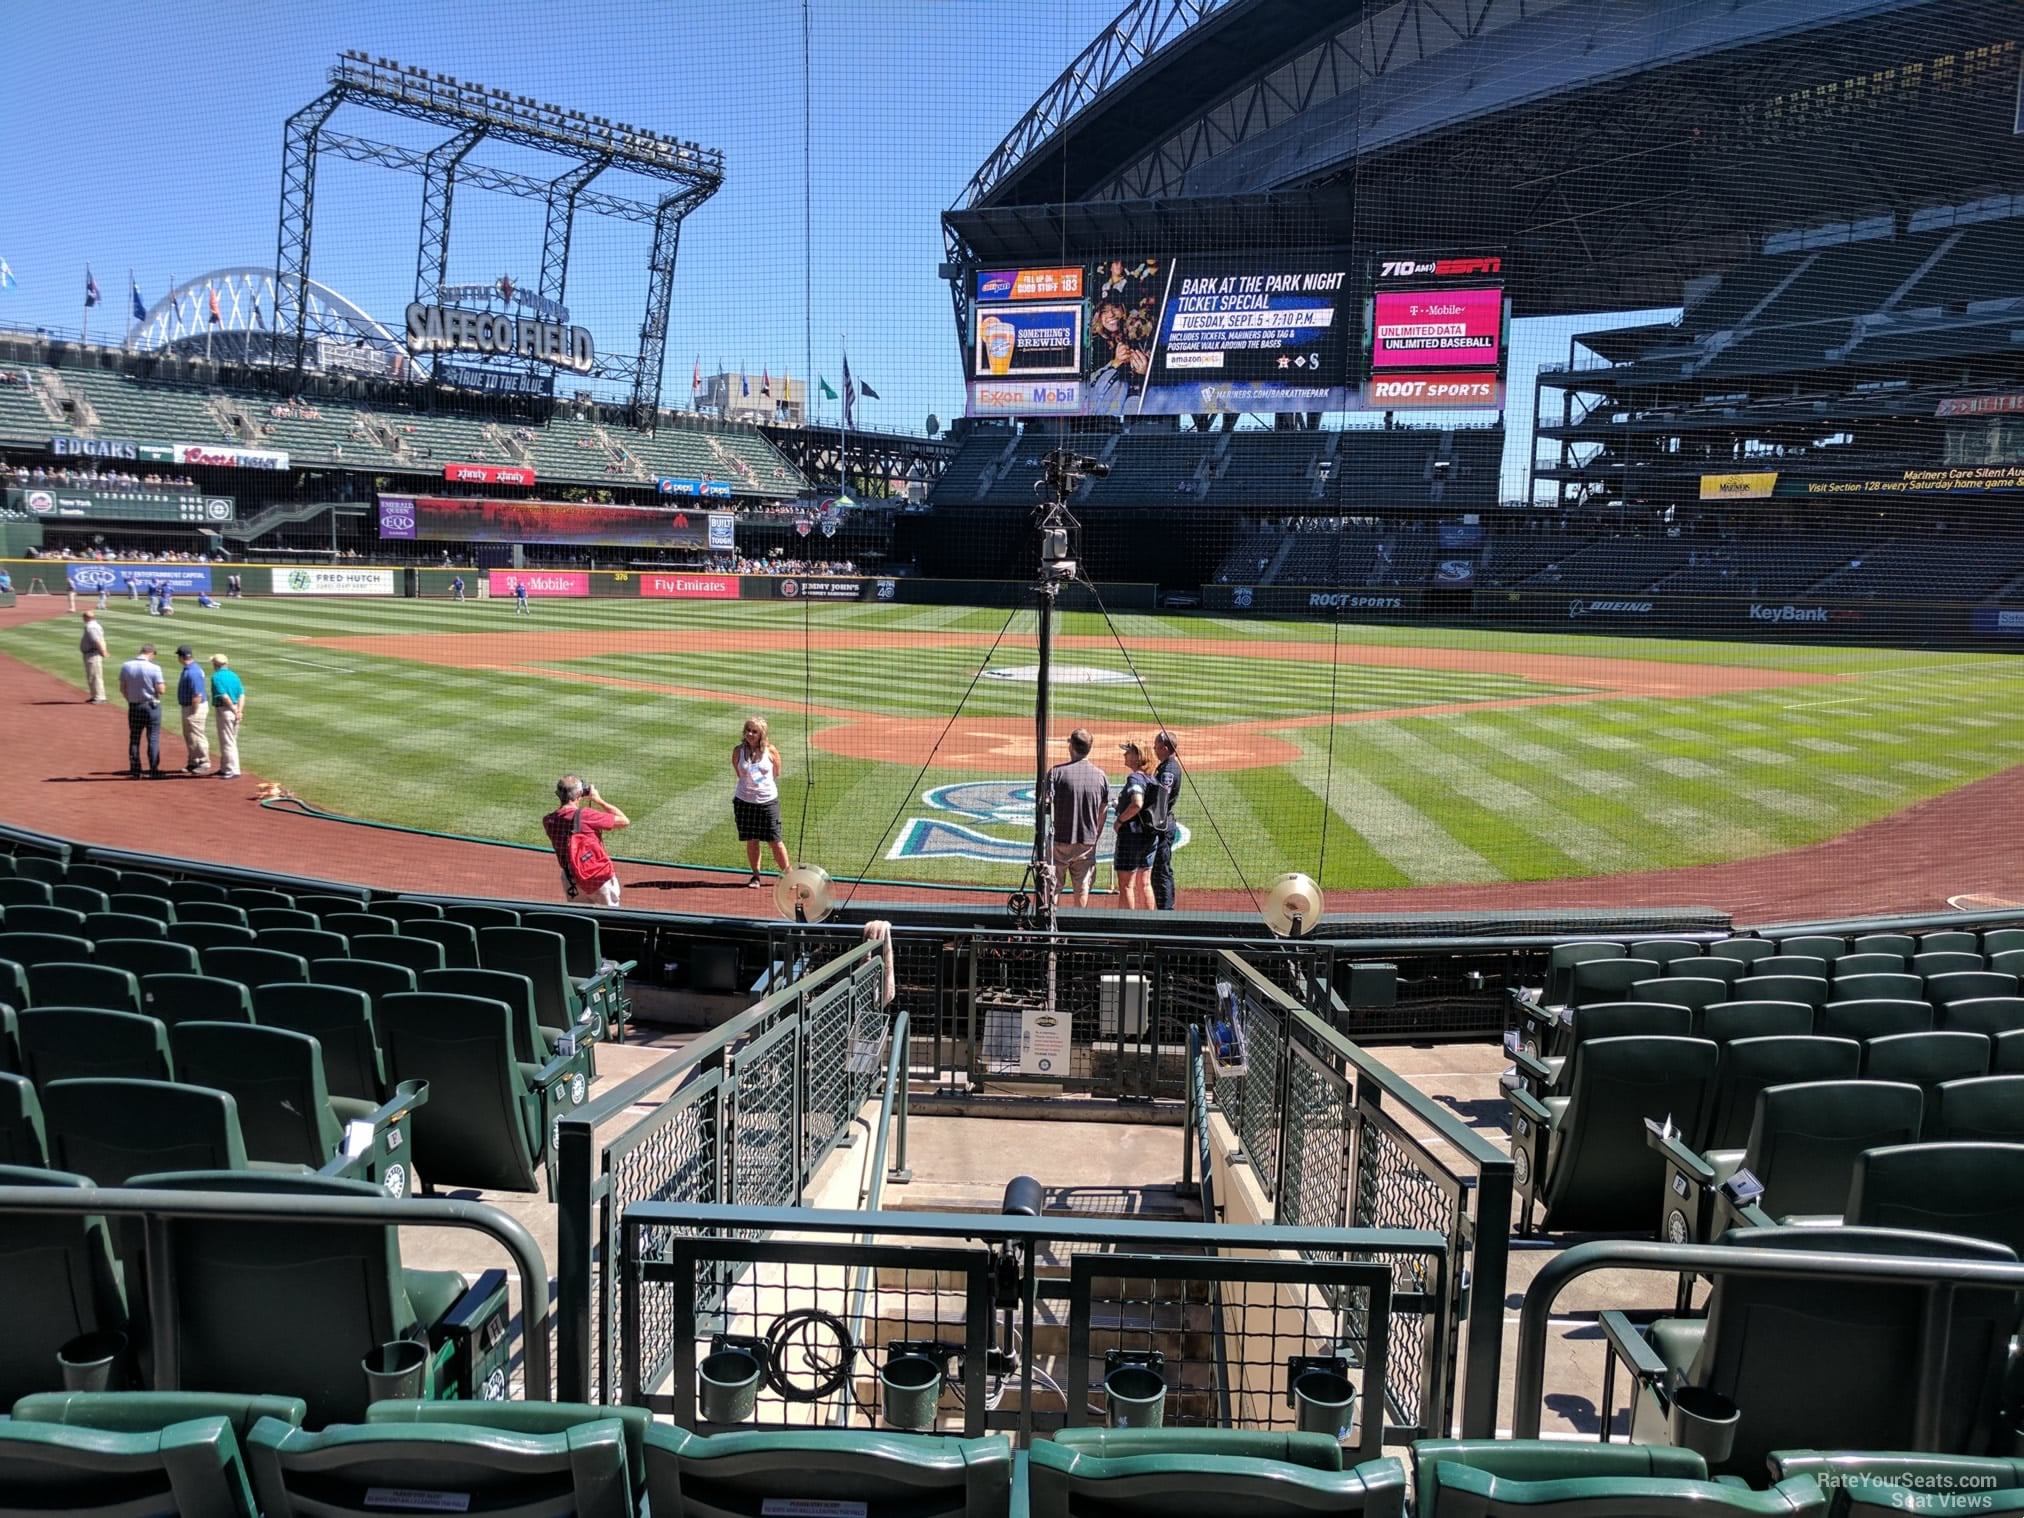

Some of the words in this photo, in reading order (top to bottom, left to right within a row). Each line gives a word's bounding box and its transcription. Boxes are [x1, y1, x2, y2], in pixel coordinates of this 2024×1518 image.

[1380, 262, 1415, 276] 710
[1435, 257, 1501, 275] ESPN
[1062, 280, 1077, 292] 183
[1181, 278, 1218, 295] BARK
[1218, 277, 1237, 294] AT
[1239, 276, 1263, 293] THE
[1265, 274, 1302, 292] PARK
[1303, 272, 1346, 290] NIGHT
[1178, 296, 1219, 312] TICKET
[1220, 295, 1269, 310] SPECIAL
[1183, 315, 1225, 329] TUESDAY,
[1227, 314, 1254, 327] SEPT.
[1256, 314, 1264, 326] 5
[1272, 313, 1293, 326] 7:10
[1295, 313, 1316, 325] P.M.
[406, 302, 514, 355] SAFECO
[517, 317, 595, 373] FIELD
[1018, 328, 1070, 338] SOMETHING'S
[1169, 333, 1199, 341] INCLUDES
[1200, 332, 1227, 341] TICKETS,
[1228, 331, 1261, 339] MARINERS
[1262, 331, 1275, 339] DOG
[1276, 330, 1289, 338] TAG
[1381, 327, 1435, 337] UNLIMITED
[1437, 326, 1461, 335] DATA
[1167, 342, 1200, 351] POSTGAME
[1201, 342, 1220, 350] WALK
[1247, 341, 1259, 349] THE
[1260, 340, 1282, 348] BASES
[1385, 339, 1439, 349] UNLIMITED
[1440, 338, 1491, 348] BASEBALL
[458, 368, 484, 387] TRUE
[485, 373, 498, 389] TO
[500, 375, 518, 391] THE
[519, 375, 545, 393] BLUE
[1375, 382, 1426, 397] ROOT
[1427, 384, 1489, 396] SPORTS
[980, 390, 1024, 407] Exxon
[1034, 388, 1074, 402] Mobil
[54, 438, 137, 459] EDGARS
[457, 468, 487, 481] xfinity
[496, 470, 524, 483] xfinity
[1904, 471, 1947, 480] Mariners
[1949, 469, 1973, 479] Care
[1975, 468, 2005, 478] Silent
[1808, 483, 1827, 492] Visit
[1829, 483, 1861, 492] Section
[1864, 482, 1880, 491] 128
[1882, 482, 1907, 492] every
[1909, 480, 1953, 491] Saturday
[1954, 479, 1984, 488] home
[1985, 480, 2014, 489] game
[711, 519, 731, 527] BUILT
[317, 574, 344, 583] FRED
[346, 574, 380, 583] HUTCH
[655, 579, 674, 592] Fly
[677, 579, 725, 592] Emirates
[831, 583, 859, 591] JOHN'S
[1309, 593, 1350, 606] ROOT
[1351, 597, 1401, 608] SPORTS
[1590, 602, 1653, 612] BOEING
[1750, 603, 1829, 623] KeyBank
